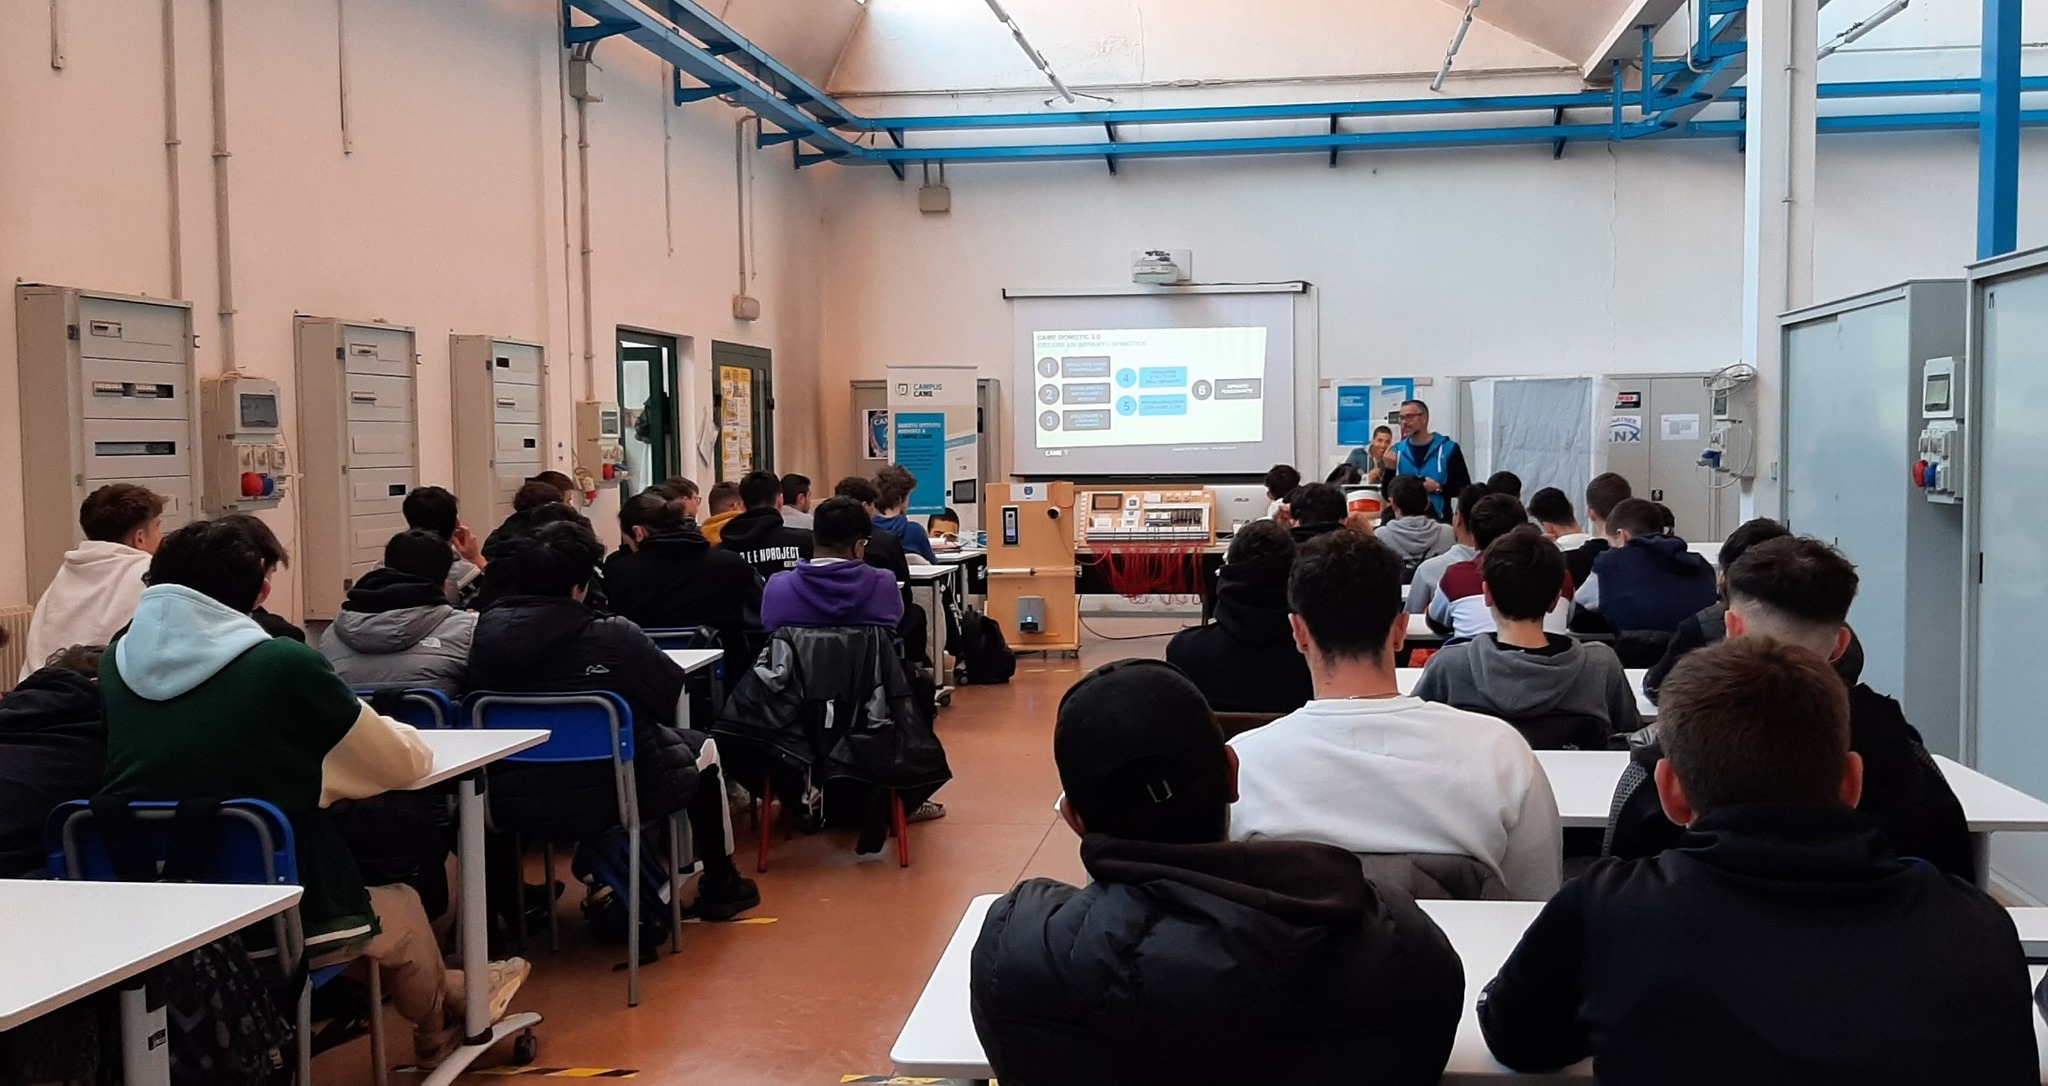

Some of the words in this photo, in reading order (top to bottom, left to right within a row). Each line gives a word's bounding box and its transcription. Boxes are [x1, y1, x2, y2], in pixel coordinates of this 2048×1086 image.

[1044, 362, 1052, 374] 1
[1122, 373, 1129, 382] 4
[1045, 389, 1053, 400] 2
[1198, 384, 1206, 396] 6
[1123, 401, 1130, 411] 5
[1046, 415, 1053, 426] 3
[1609, 431, 1640, 442] NX
